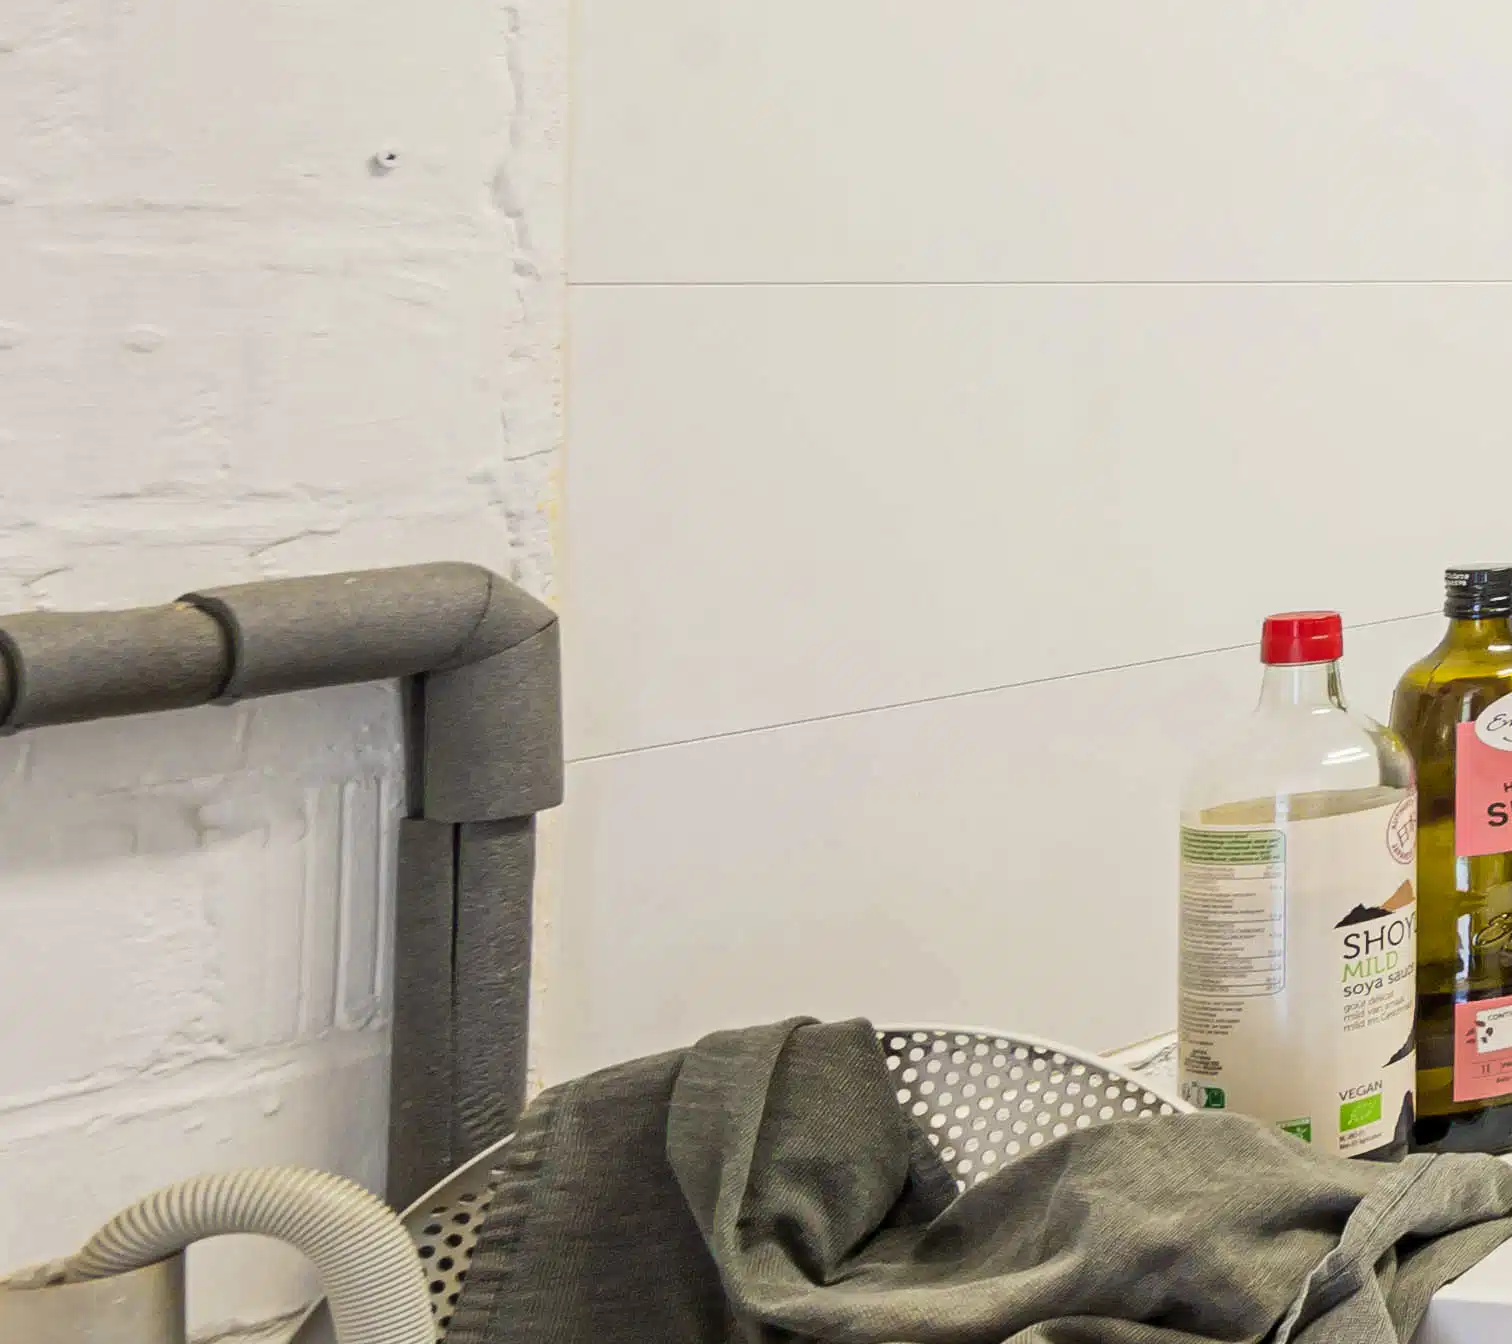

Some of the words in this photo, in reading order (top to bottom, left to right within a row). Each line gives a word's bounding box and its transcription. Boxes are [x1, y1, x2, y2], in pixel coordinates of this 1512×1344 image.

[1343, 911, 1416, 960] SHOY
[1341, 950, 1398, 984] MILD
[1343, 976, 1384, 998] soya
[1339, 1080, 1383, 1102] VEGAN
